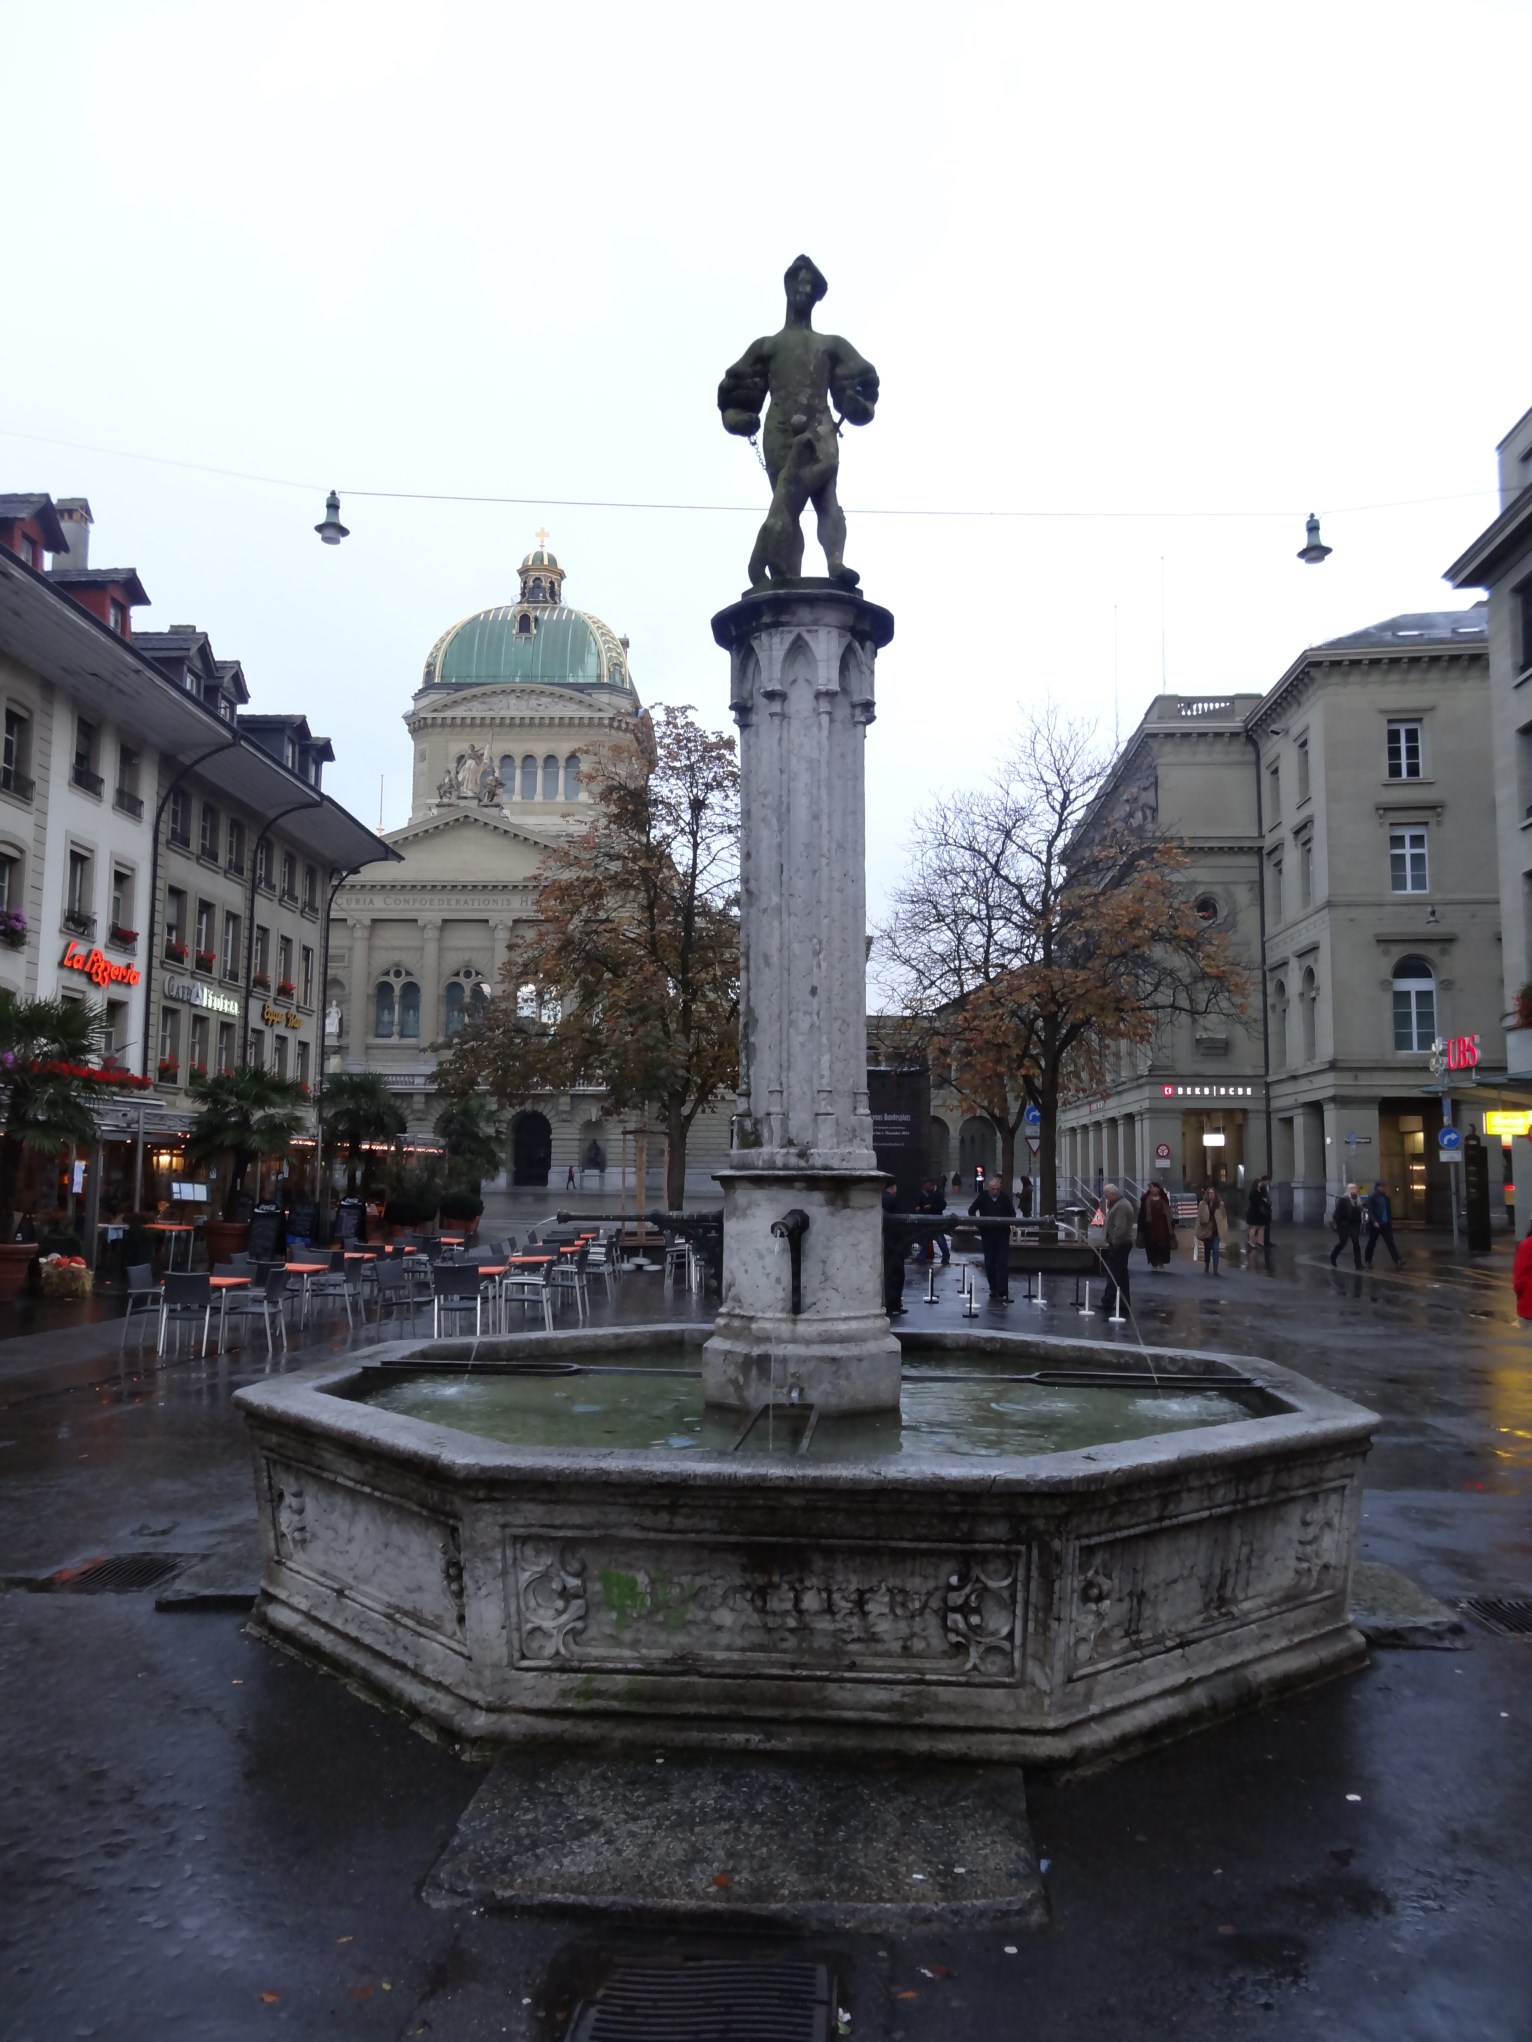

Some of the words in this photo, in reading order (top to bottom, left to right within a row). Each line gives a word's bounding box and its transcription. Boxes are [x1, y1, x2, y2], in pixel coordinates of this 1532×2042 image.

[334, 896, 375, 907] CURIA
[383, 896, 512, 907] CONFOEDERATIONIS
[63, 940, 86, 968] La
[84, 947, 141, 987] Pizzeria
[1447, 1034, 1479, 1070] UBS
